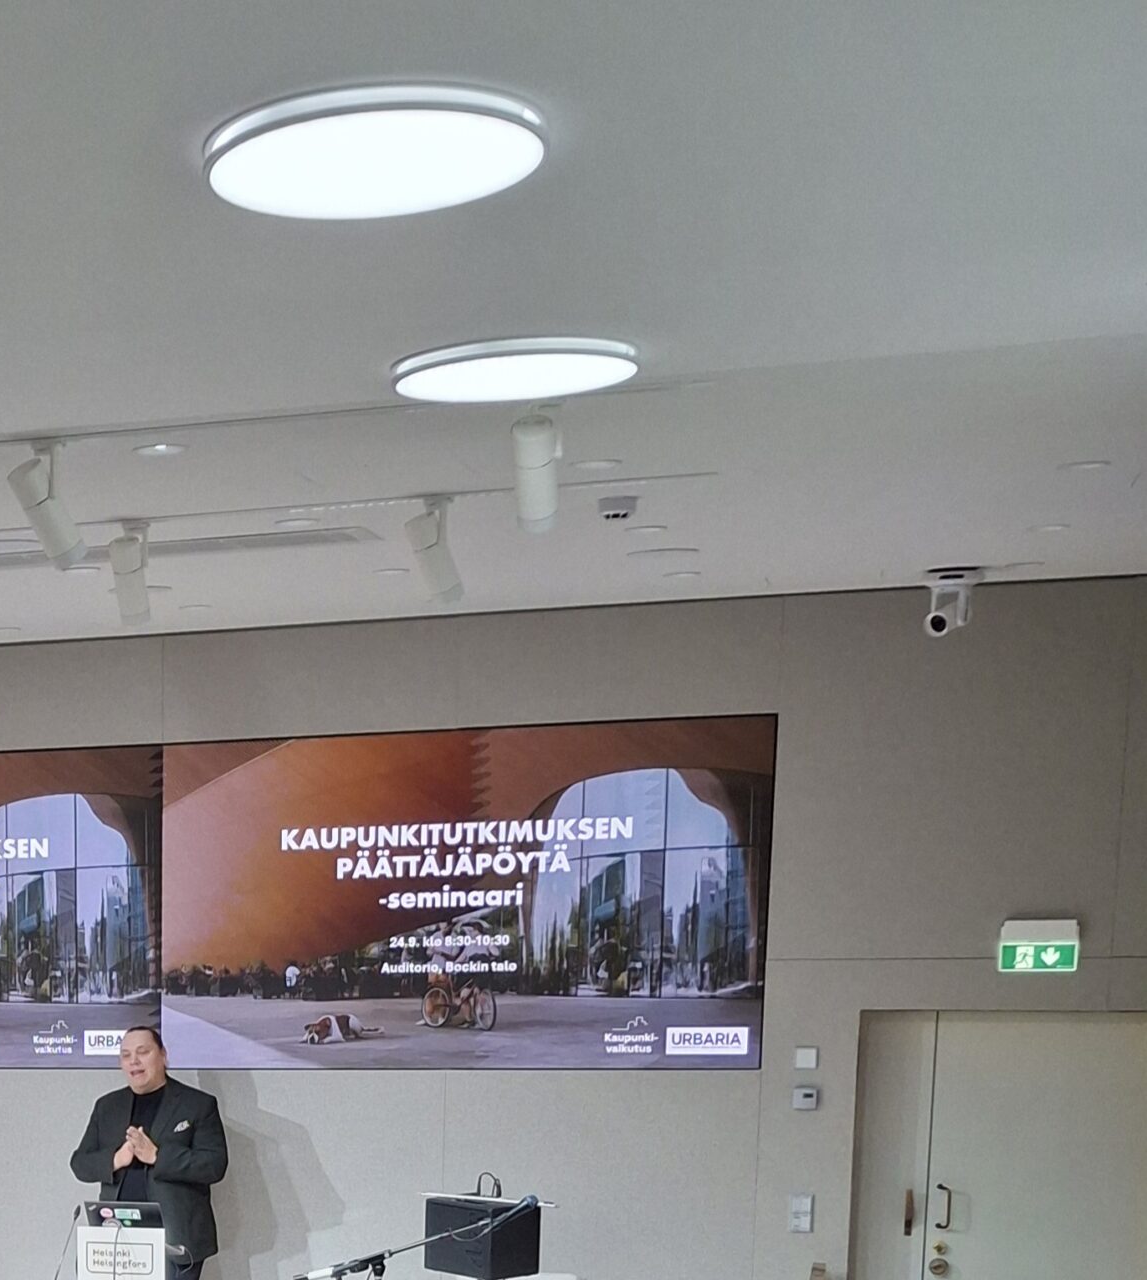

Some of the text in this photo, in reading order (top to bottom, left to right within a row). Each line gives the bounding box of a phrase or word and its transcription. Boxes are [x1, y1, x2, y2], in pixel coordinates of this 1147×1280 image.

[281, 816, 634, 851] KAUPUNKITUTKIMUKSEN
[336, 844, 571, 879] PÄÄTTÄJÄPÖYTÄ
[379, 882, 523, 909] -seminaari
[422, 936, 442, 947] klo
[445, 934, 510, 946] 8:30-10:30
[381, 962, 442, 974] Auditorio,
[491, 960, 518, 972] talo
[33, 1035, 77, 1045] Kaupunki-
[88, 1034, 123, 1047] URBA
[604, 1033, 659, 1044] Kaupunki-
[671, 1032, 741, 1046] URBARIA
[605, 1044, 652, 1054] vaikutus
[93, 1248, 131, 1257] Helsnki
[93, 1258, 147, 1270] Helsngfors
